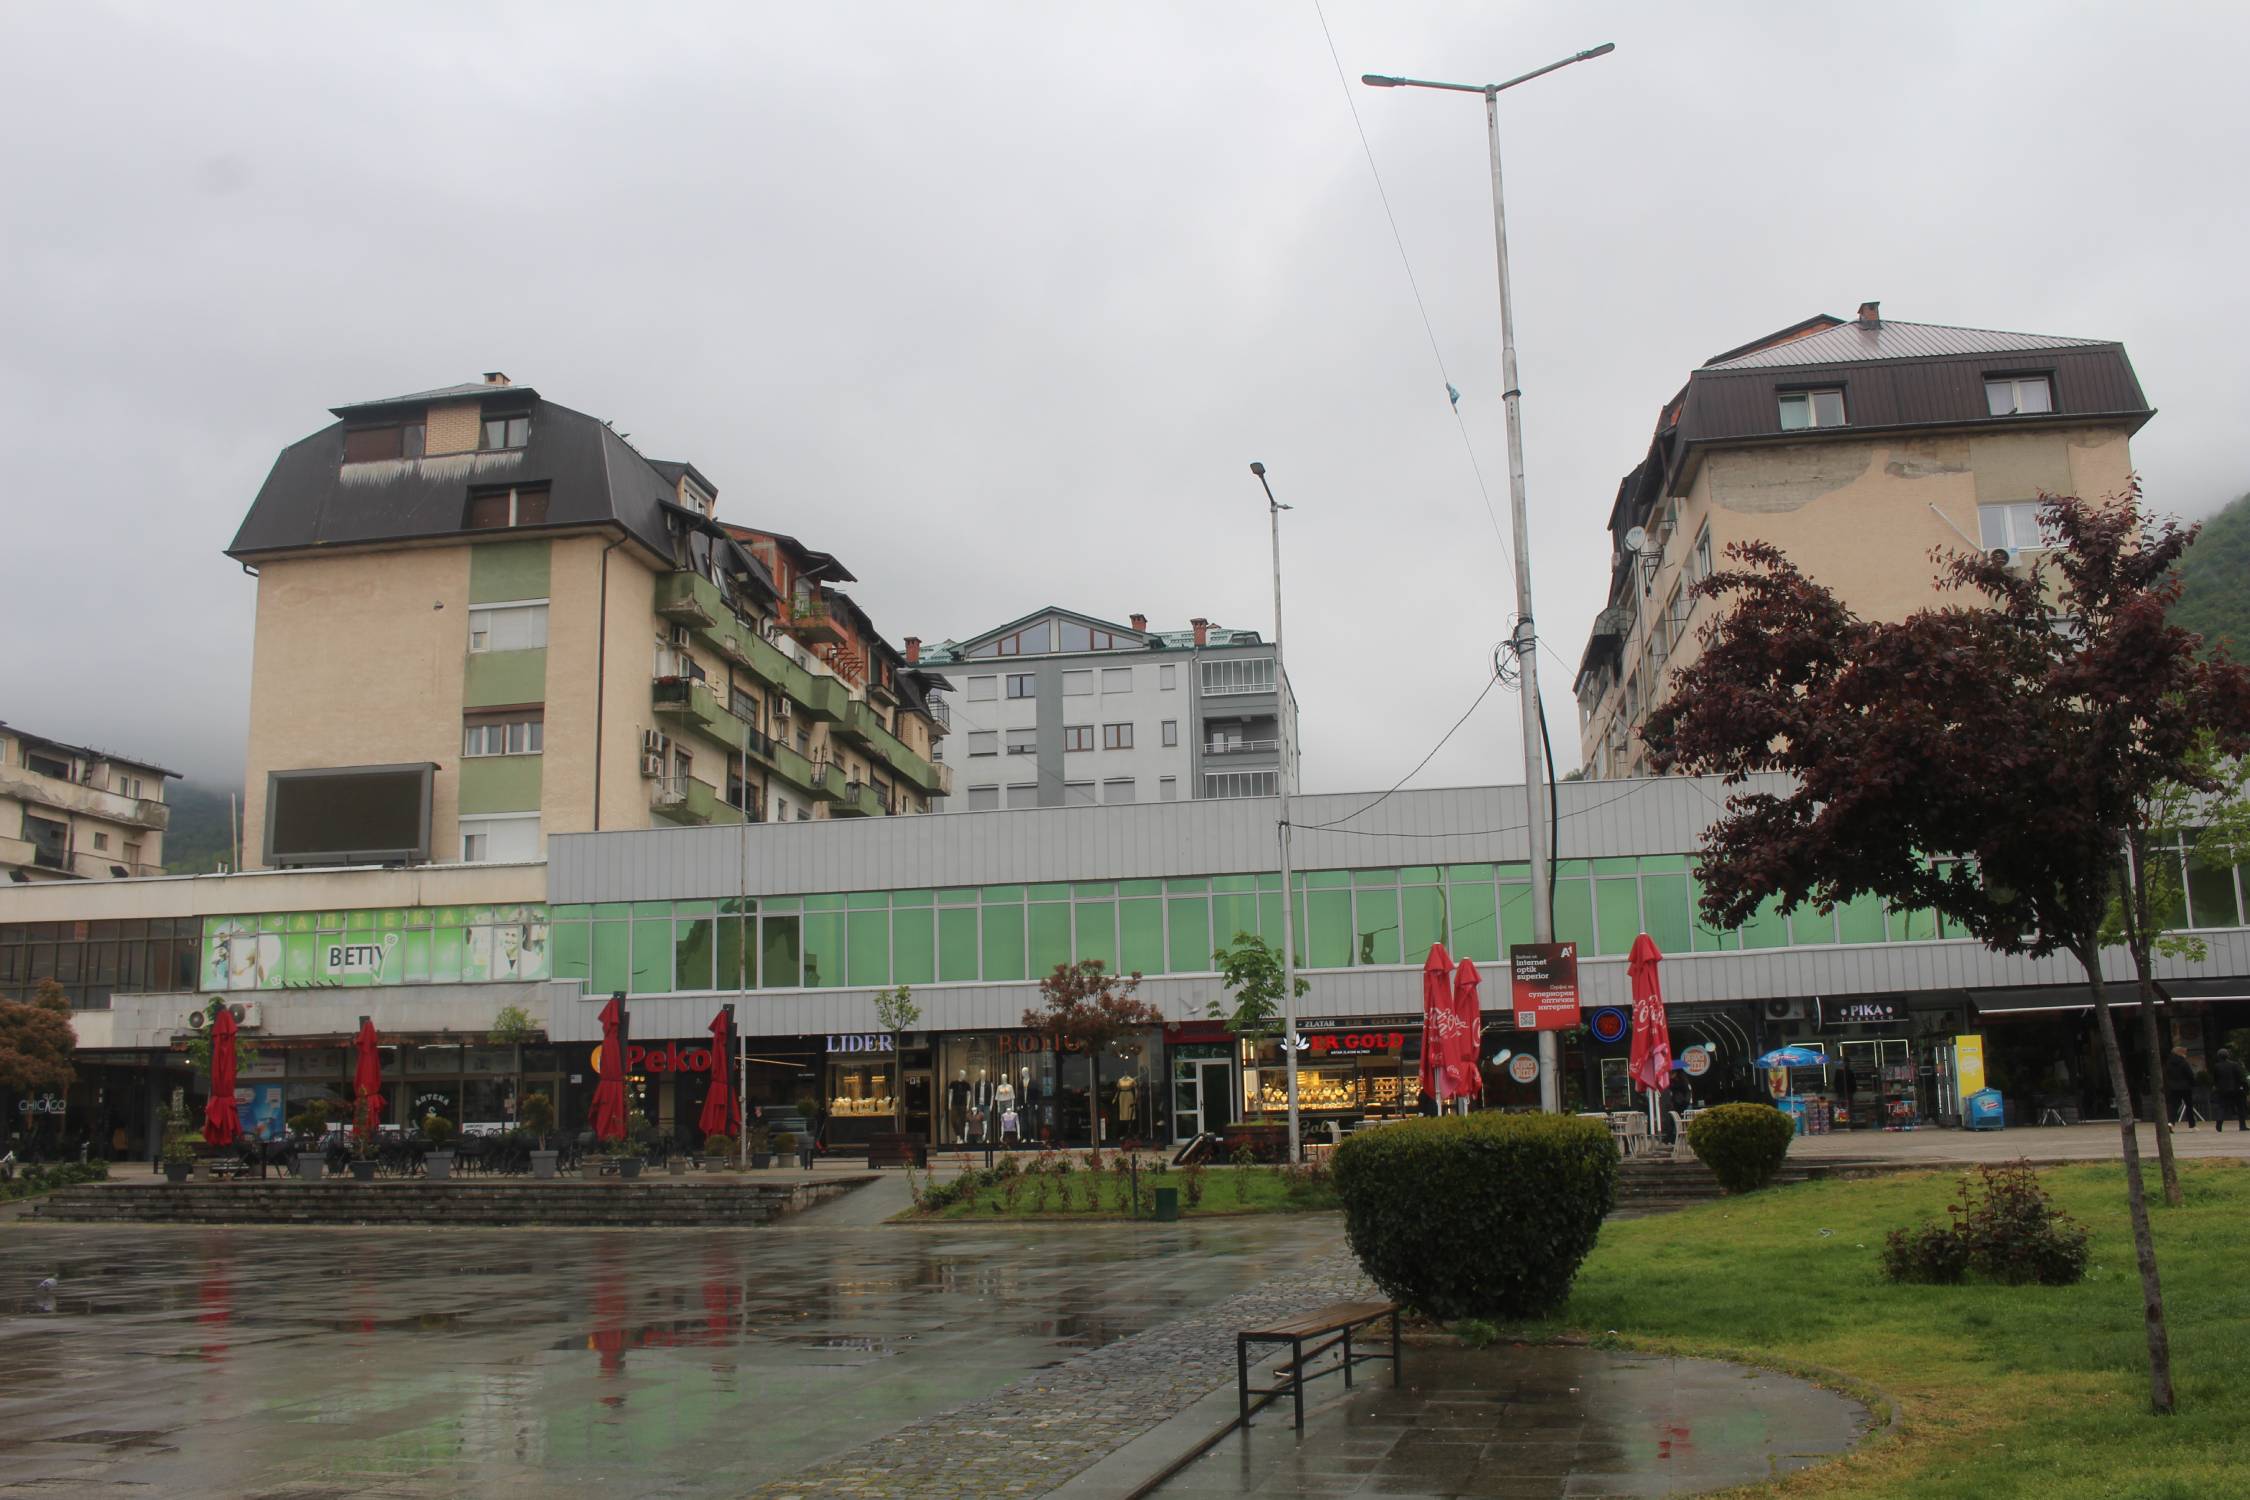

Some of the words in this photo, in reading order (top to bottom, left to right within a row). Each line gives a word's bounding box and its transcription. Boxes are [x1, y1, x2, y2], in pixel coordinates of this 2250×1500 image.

[295, 911, 455, 929] АПТЕКА
[329, 944, 387, 966] BETTY
[1560, 945, 1573, 958] A1
[1516, 966, 1537, 975] optik
[1517, 973, 1549, 981] superior
[1850, 1005, 1884, 1016] PIKA
[826, 1034, 894, 1053] LIDER
[1344, 1033, 1404, 1049] GOLD
